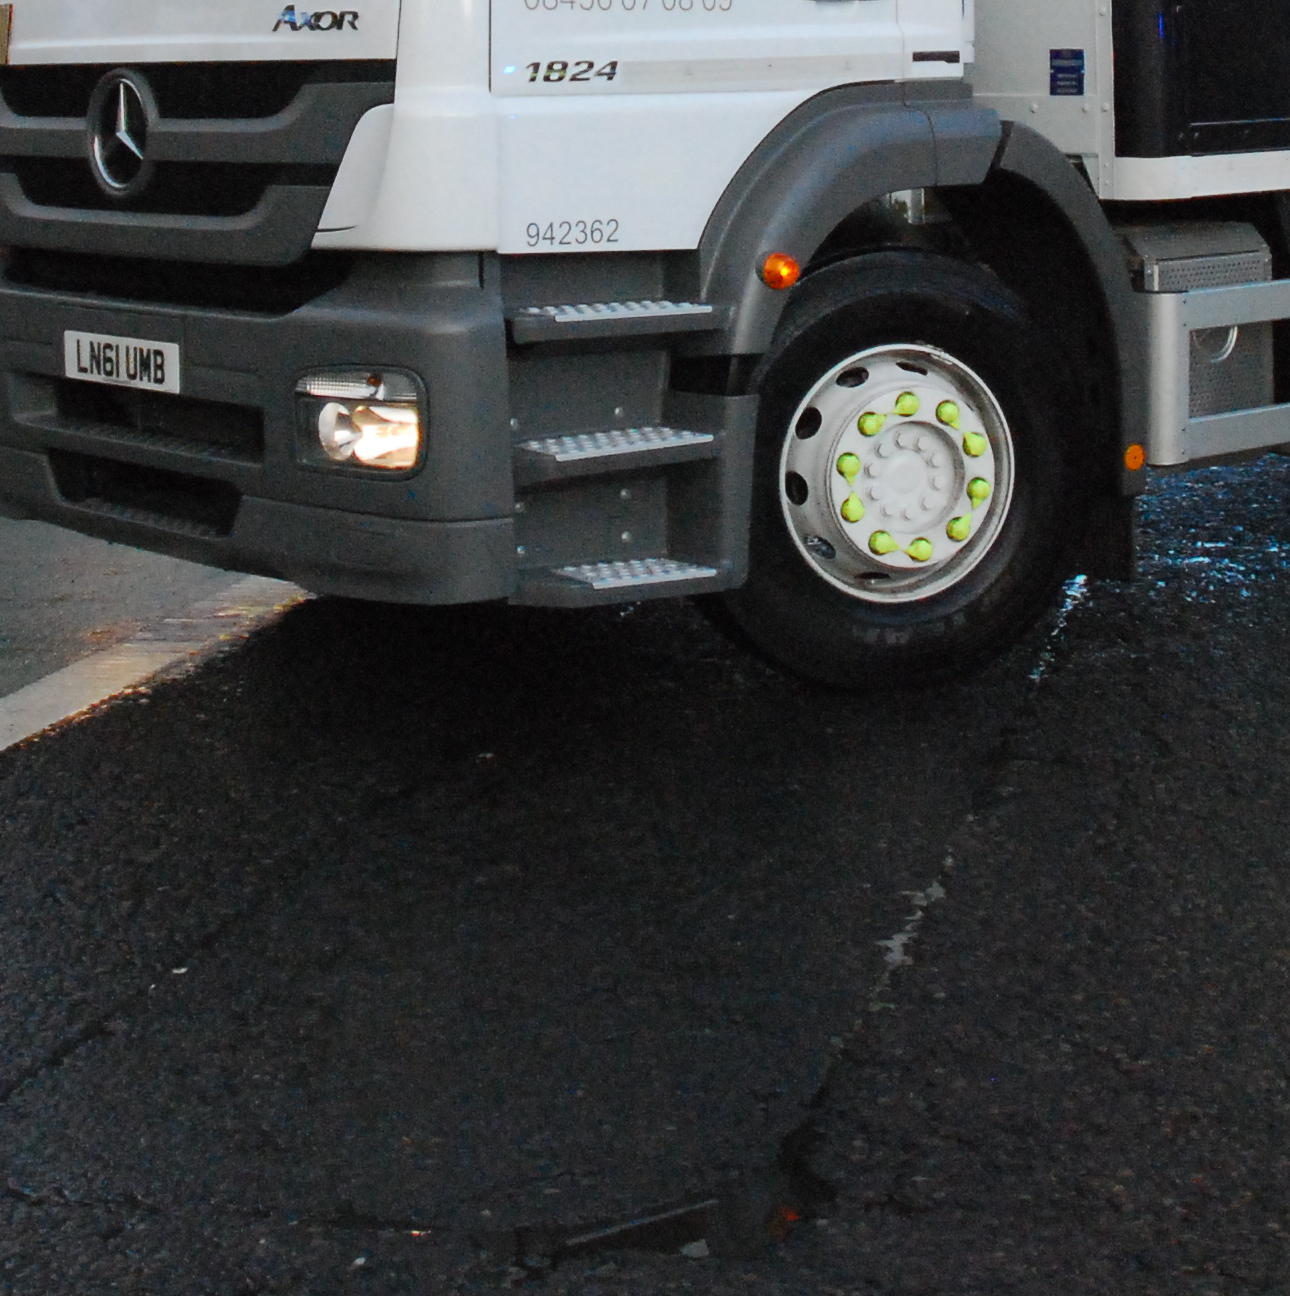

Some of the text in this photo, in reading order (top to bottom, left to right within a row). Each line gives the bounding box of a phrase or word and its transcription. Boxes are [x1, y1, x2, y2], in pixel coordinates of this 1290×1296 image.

[525, 60, 618, 83] 1824
[526, 218, 619, 247] 942362
[76, 338, 166, 385] LN61 UMB
